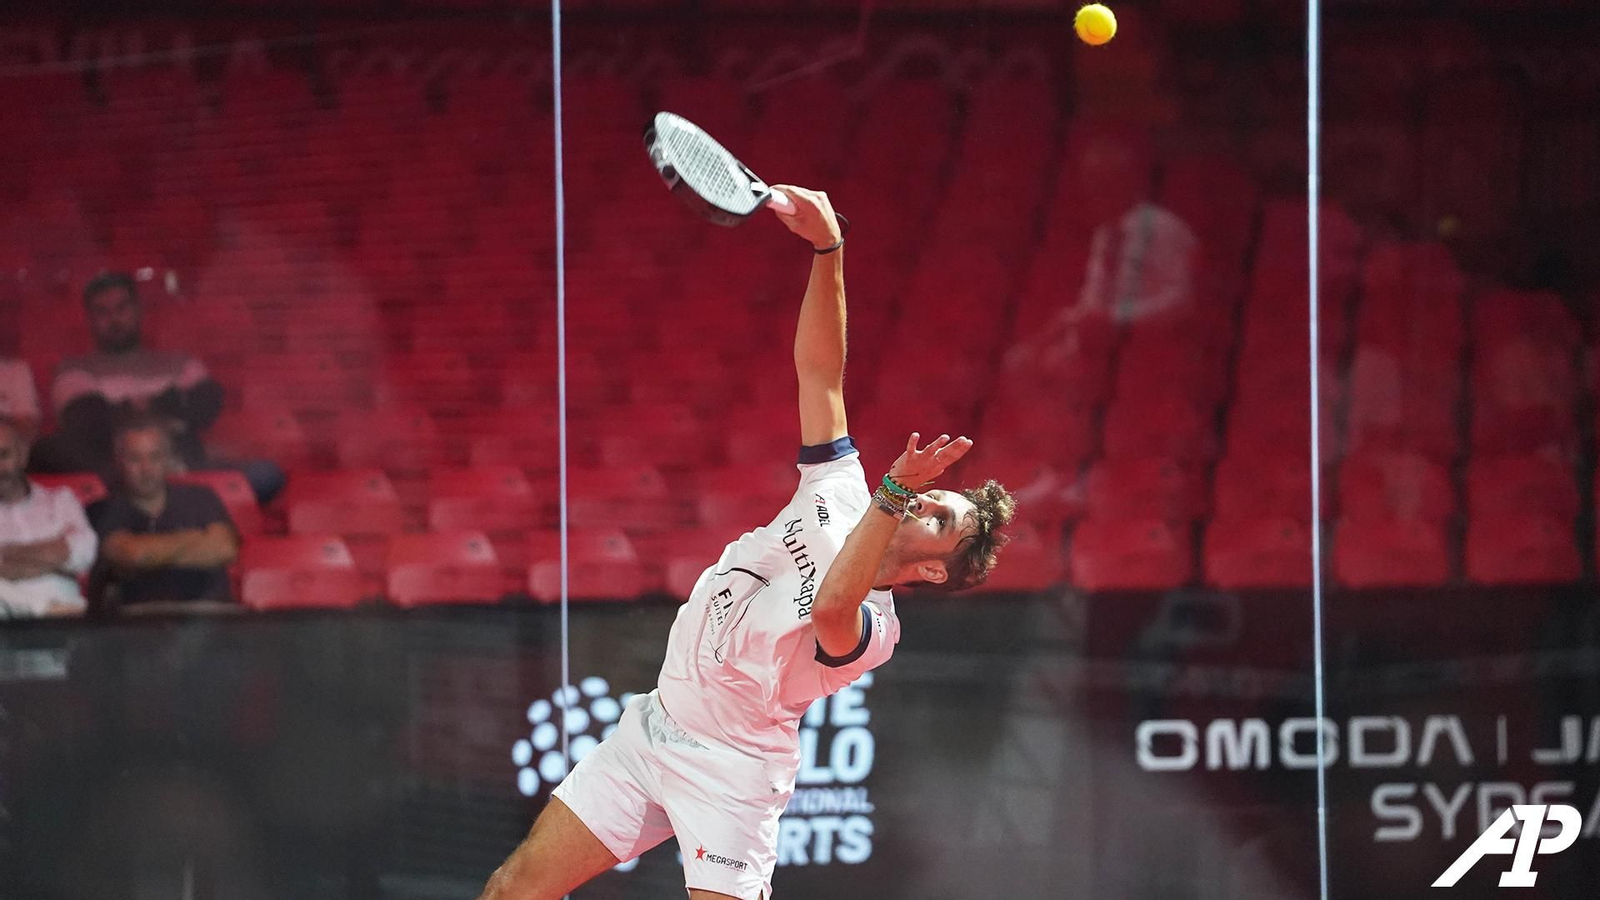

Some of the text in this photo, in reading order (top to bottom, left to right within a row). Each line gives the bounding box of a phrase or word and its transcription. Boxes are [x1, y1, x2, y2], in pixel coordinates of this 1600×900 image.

[710, 595, 724, 626] SUITES
[1135, 714, 1474, 771] OMODA
[777, 816, 874, 865] RTS
[706, 853, 748, 871] MEGASPORT
